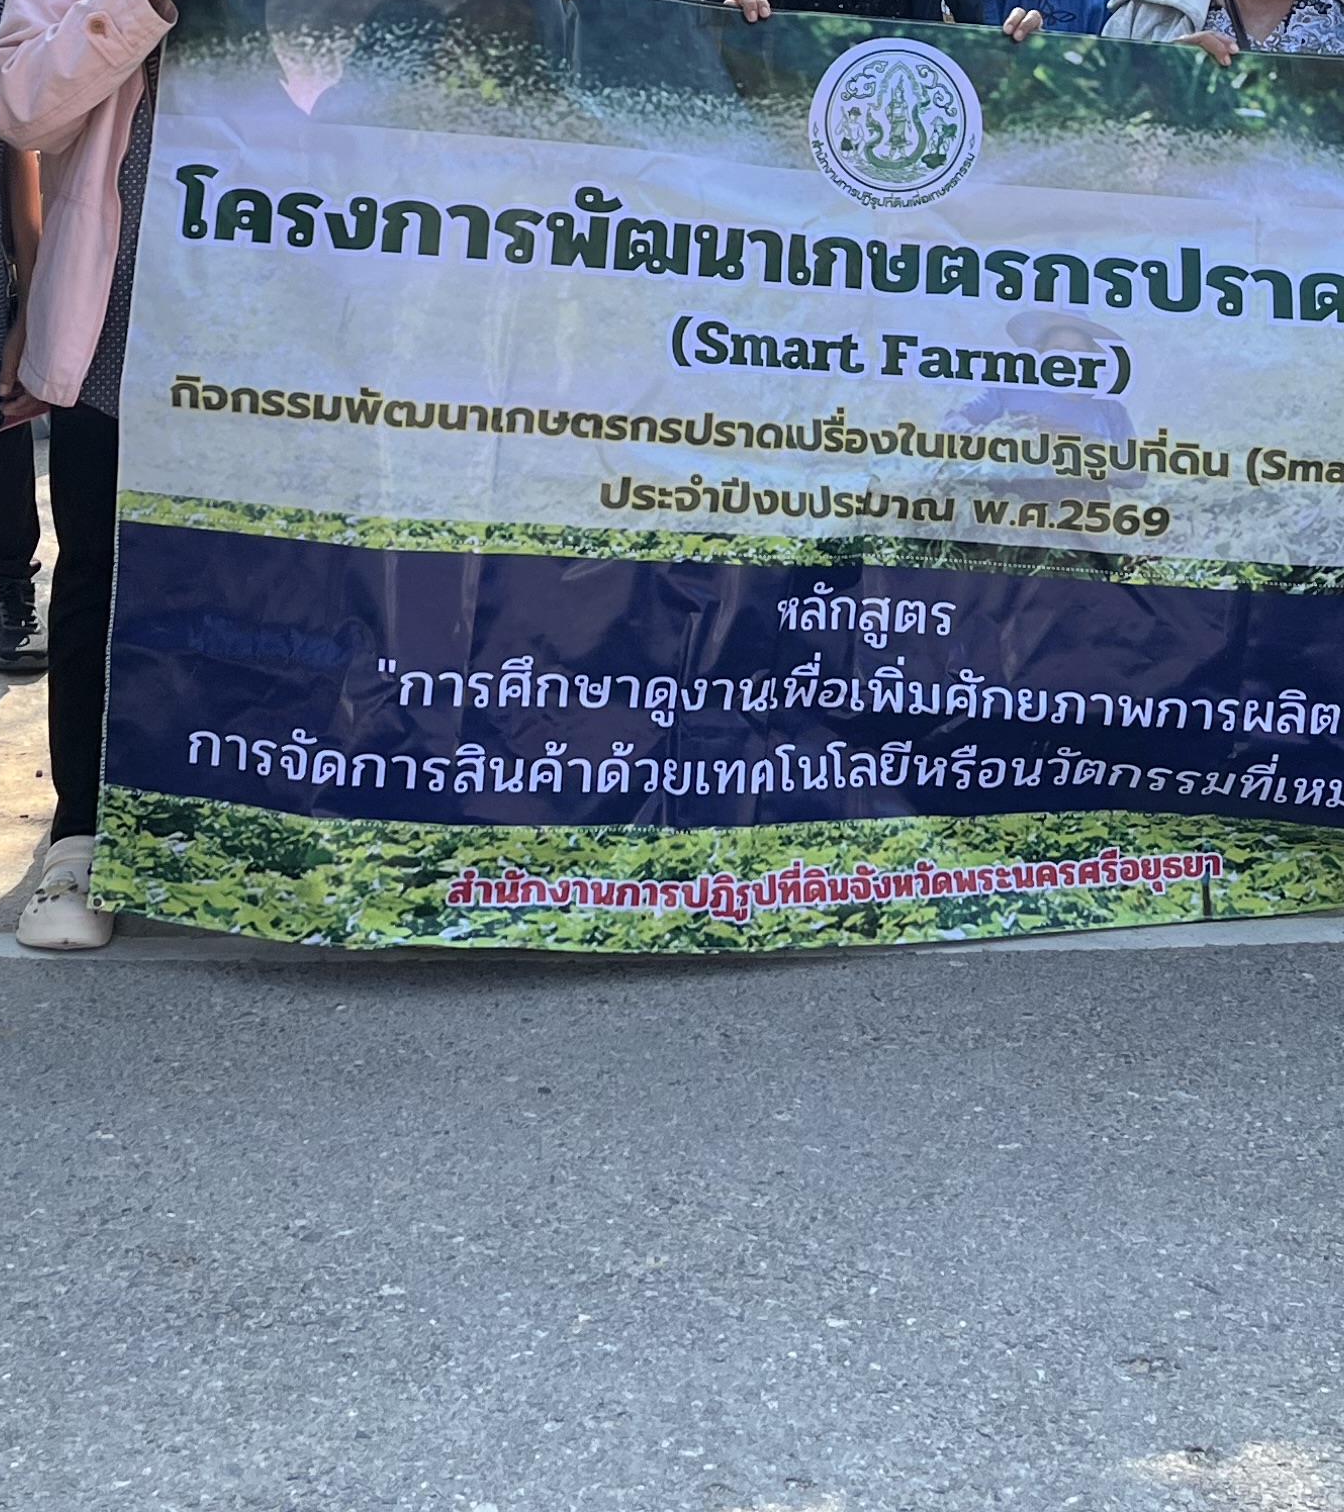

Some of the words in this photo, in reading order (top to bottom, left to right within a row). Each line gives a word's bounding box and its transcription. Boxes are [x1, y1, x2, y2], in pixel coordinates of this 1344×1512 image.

[672, 316, 865, 373] (Smart
[881, 334, 1131, 395] Farmer)
[171, 374, 1230, 481] กิจกรรมพัฒนาเกษตรกรปราดเปรื่องในเขตปฏิรูปที่ดิน
[601, 474, 955, 523] ประจำปีงบประมาณ
[973, 500, 1170, 536] พ.ศ.2569
[777, 582, 956, 649] หลักสูตร
[378, 651, 1341, 736] "การศึกษาดูงานเพื่อเพิ่มศักยภาพการผลิต
[448, 848, 1221, 920] สำนักงานการปฏิรูปที่ดินจังหวัดพระนครศรีอยุธยา
